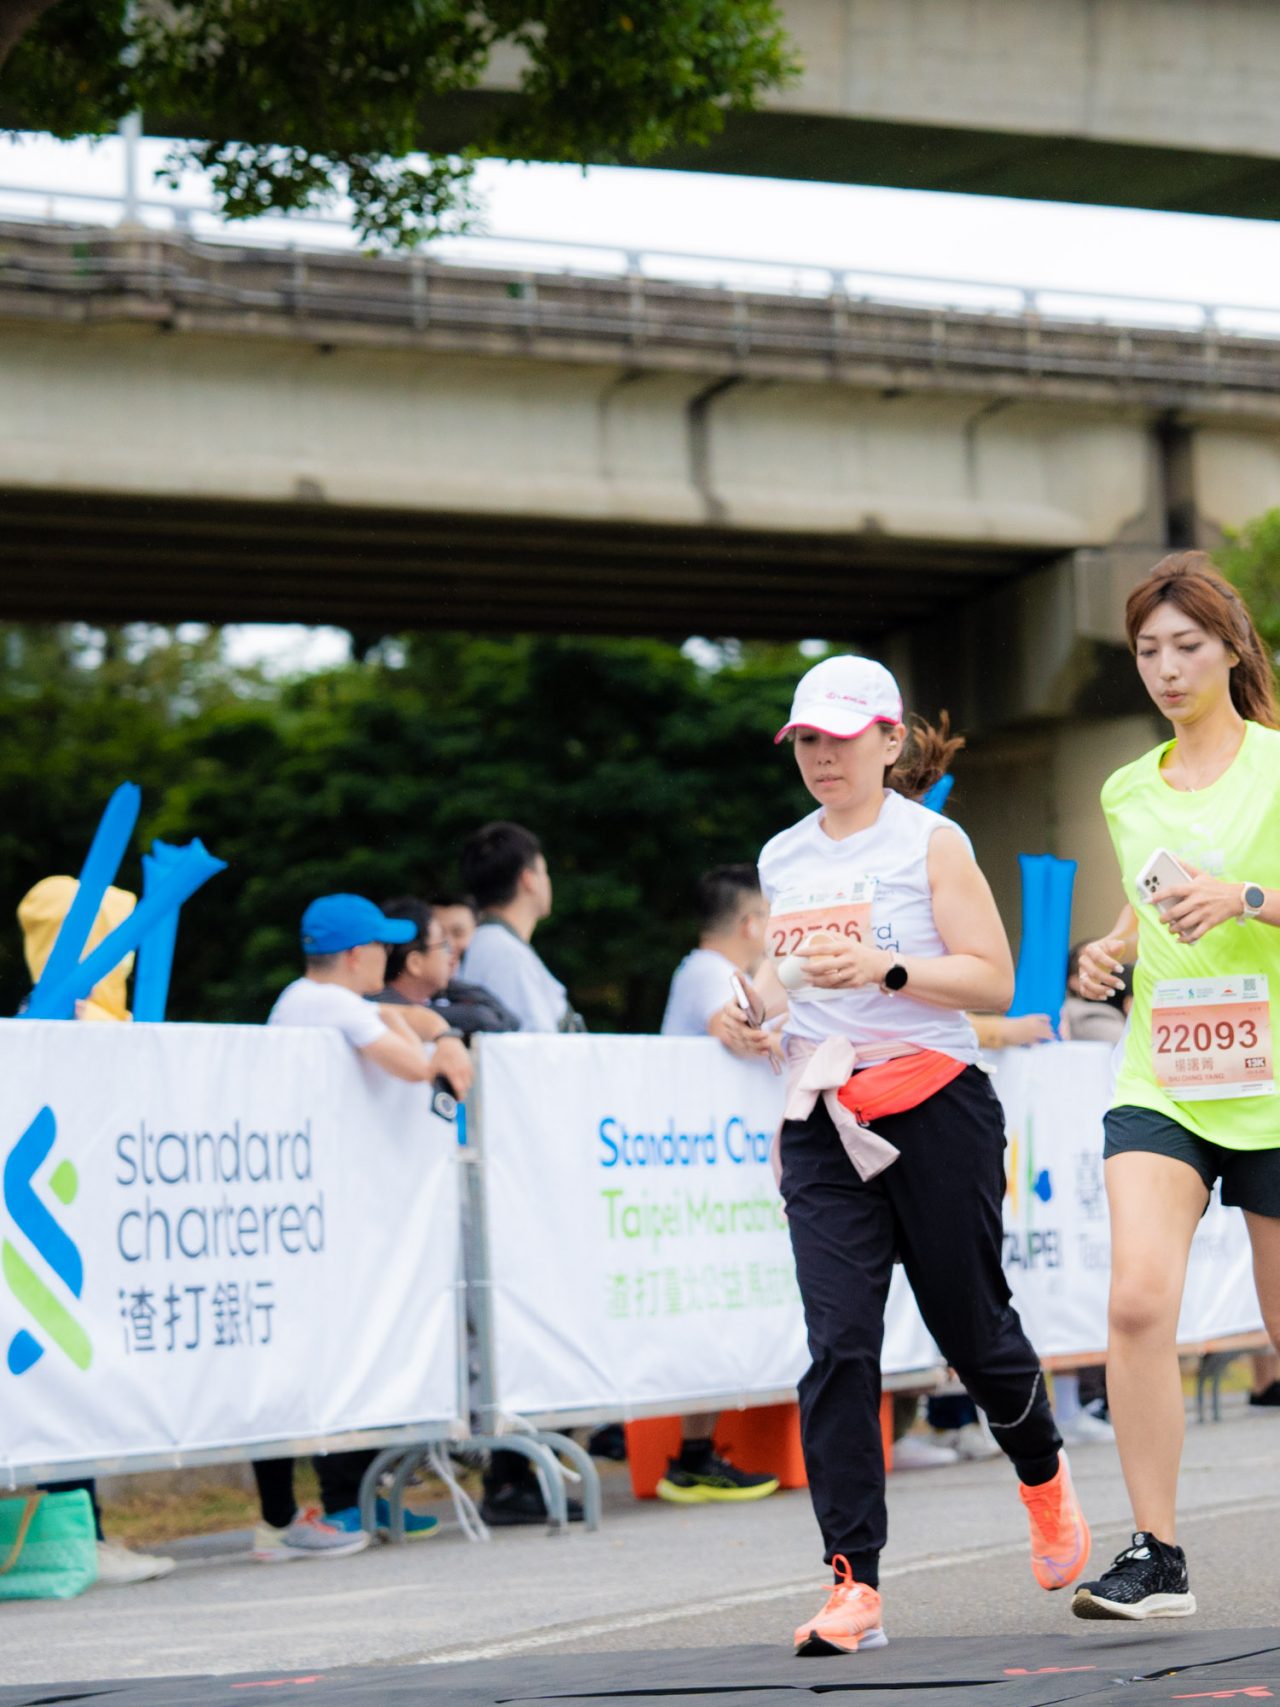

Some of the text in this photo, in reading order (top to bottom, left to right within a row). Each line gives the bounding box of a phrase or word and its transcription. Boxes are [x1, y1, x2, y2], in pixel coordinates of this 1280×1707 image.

[771, 920, 862, 957] 226
[1157, 1019, 1258, 1054] 22093
[116, 1117, 312, 1187] standard
[598, 1115, 774, 1168] Standard Cha
[117, 1191, 326, 1263] chartered
[600, 1183, 788, 1255] Taipei Maratho
[118, 1280, 275, 1355] 渣打銀行
